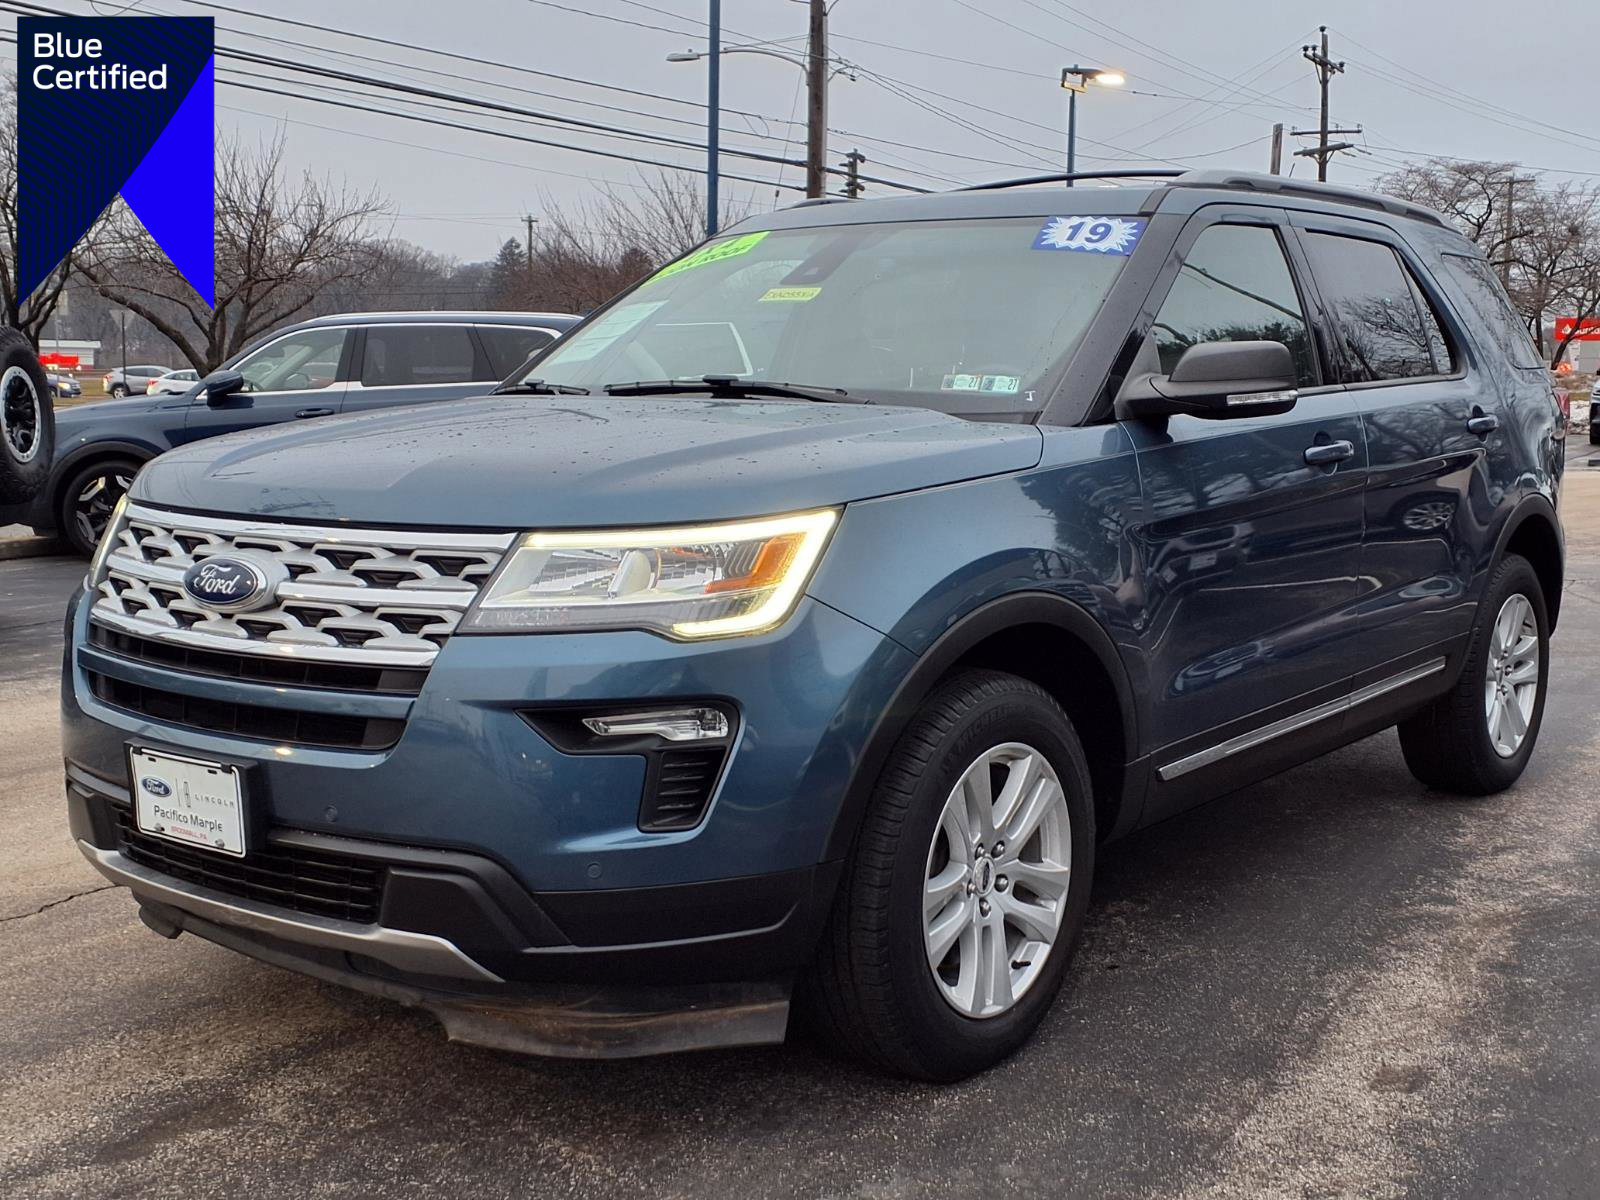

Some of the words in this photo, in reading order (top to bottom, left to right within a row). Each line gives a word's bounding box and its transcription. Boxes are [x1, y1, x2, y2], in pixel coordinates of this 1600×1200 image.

[1066, 222, 1112, 243] 19
[194, 564, 241, 595] Ford
[146, 779, 165, 794] Ford
[195, 794, 235, 809] LINCOLN
[154, 805, 188, 824] Pacifico
[190, 814, 223, 832] Marple
